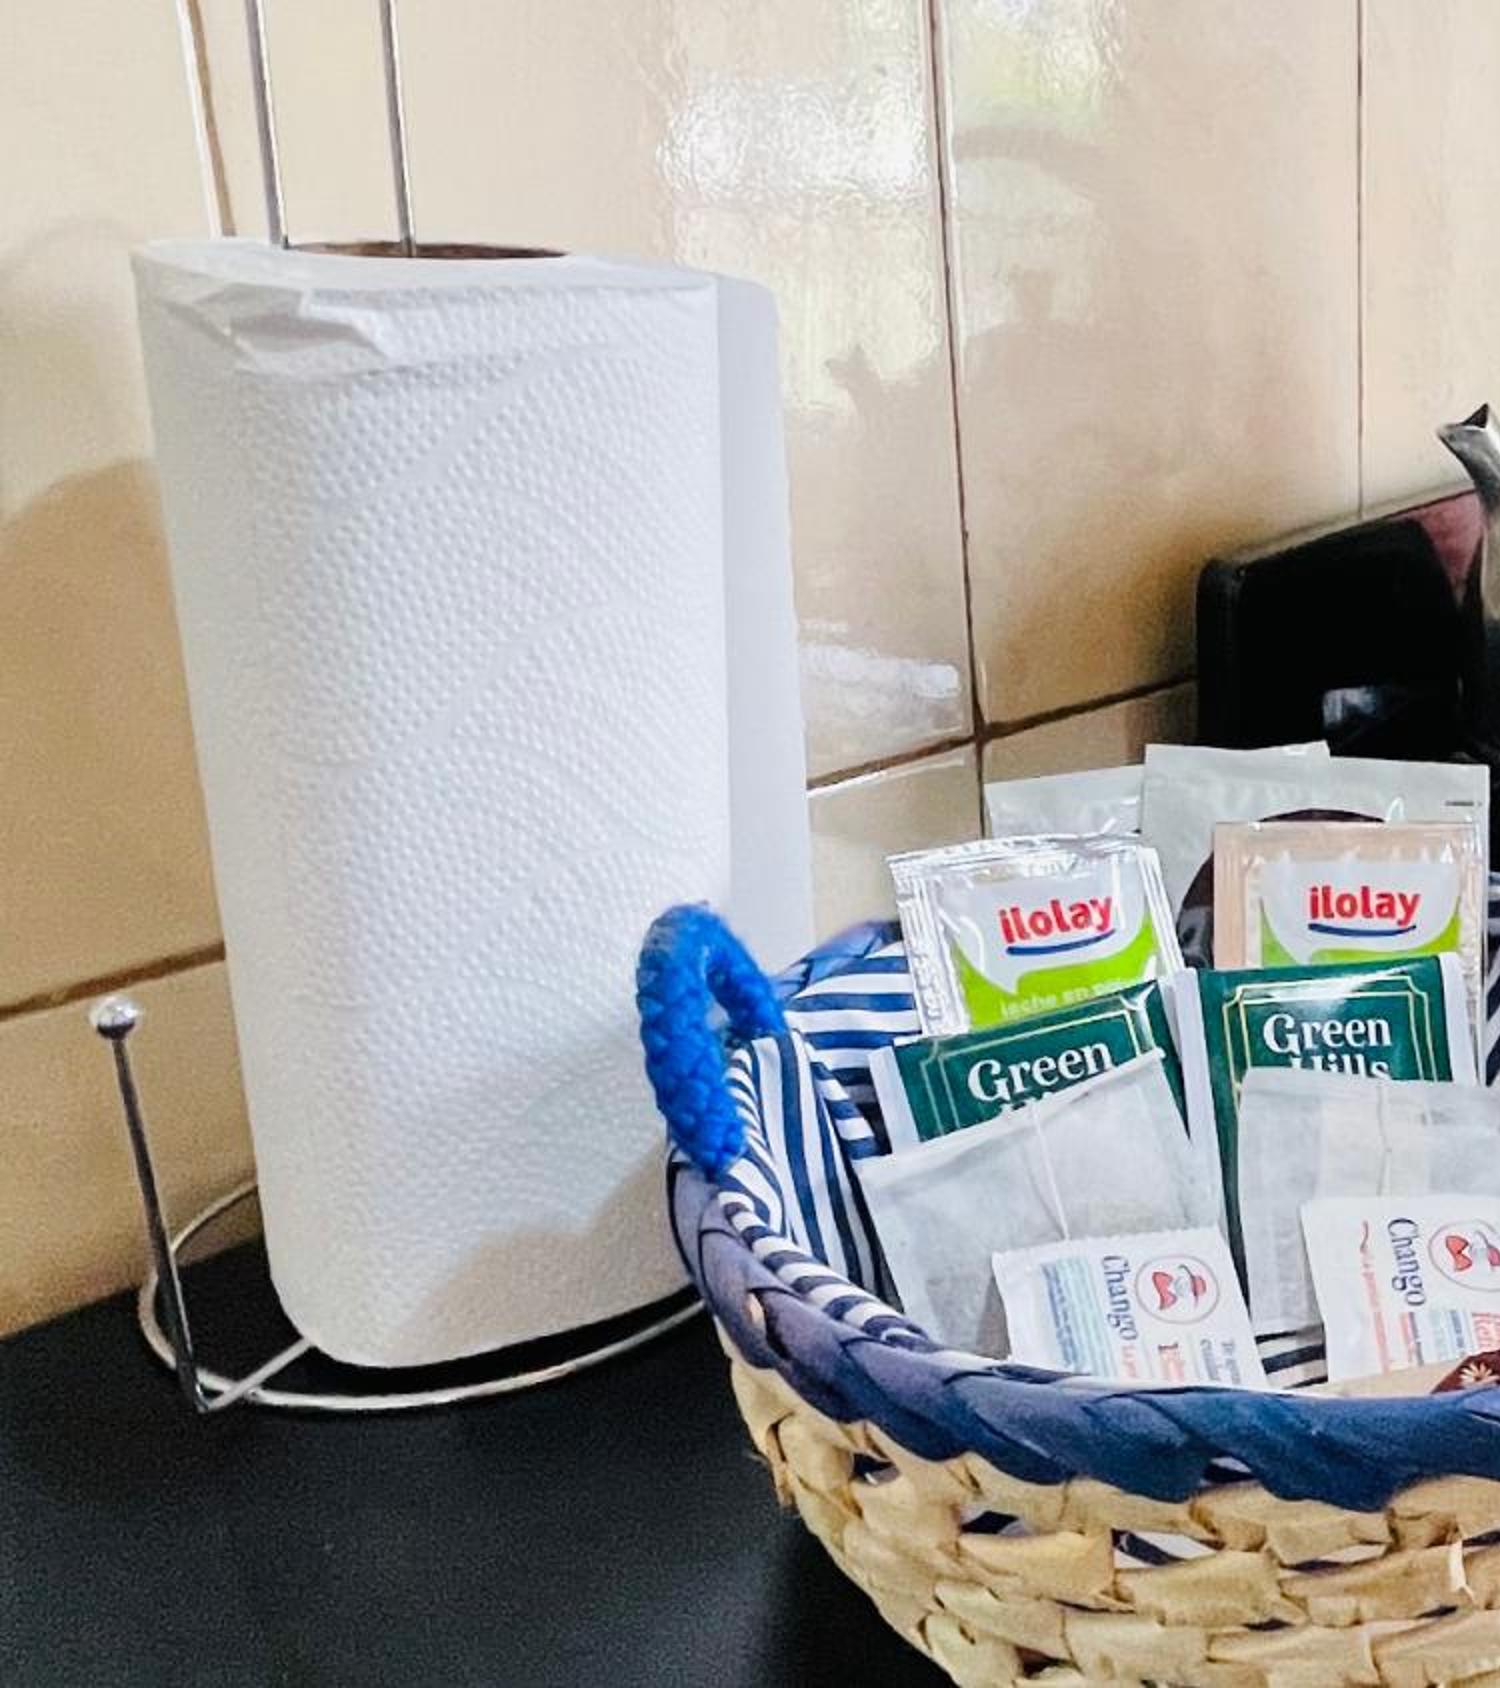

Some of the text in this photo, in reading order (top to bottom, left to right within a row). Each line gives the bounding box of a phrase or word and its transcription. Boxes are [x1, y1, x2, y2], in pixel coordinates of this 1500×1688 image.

[999, 896, 1113, 943] ilolay
[1310, 885, 1421, 926] ilolay
[1263, 1013, 1392, 1055] Green
[967, 1041, 1117, 1102] Green
[1387, 1217, 1426, 1307] Chango
[1102, 1255, 1139, 1341] Chango
